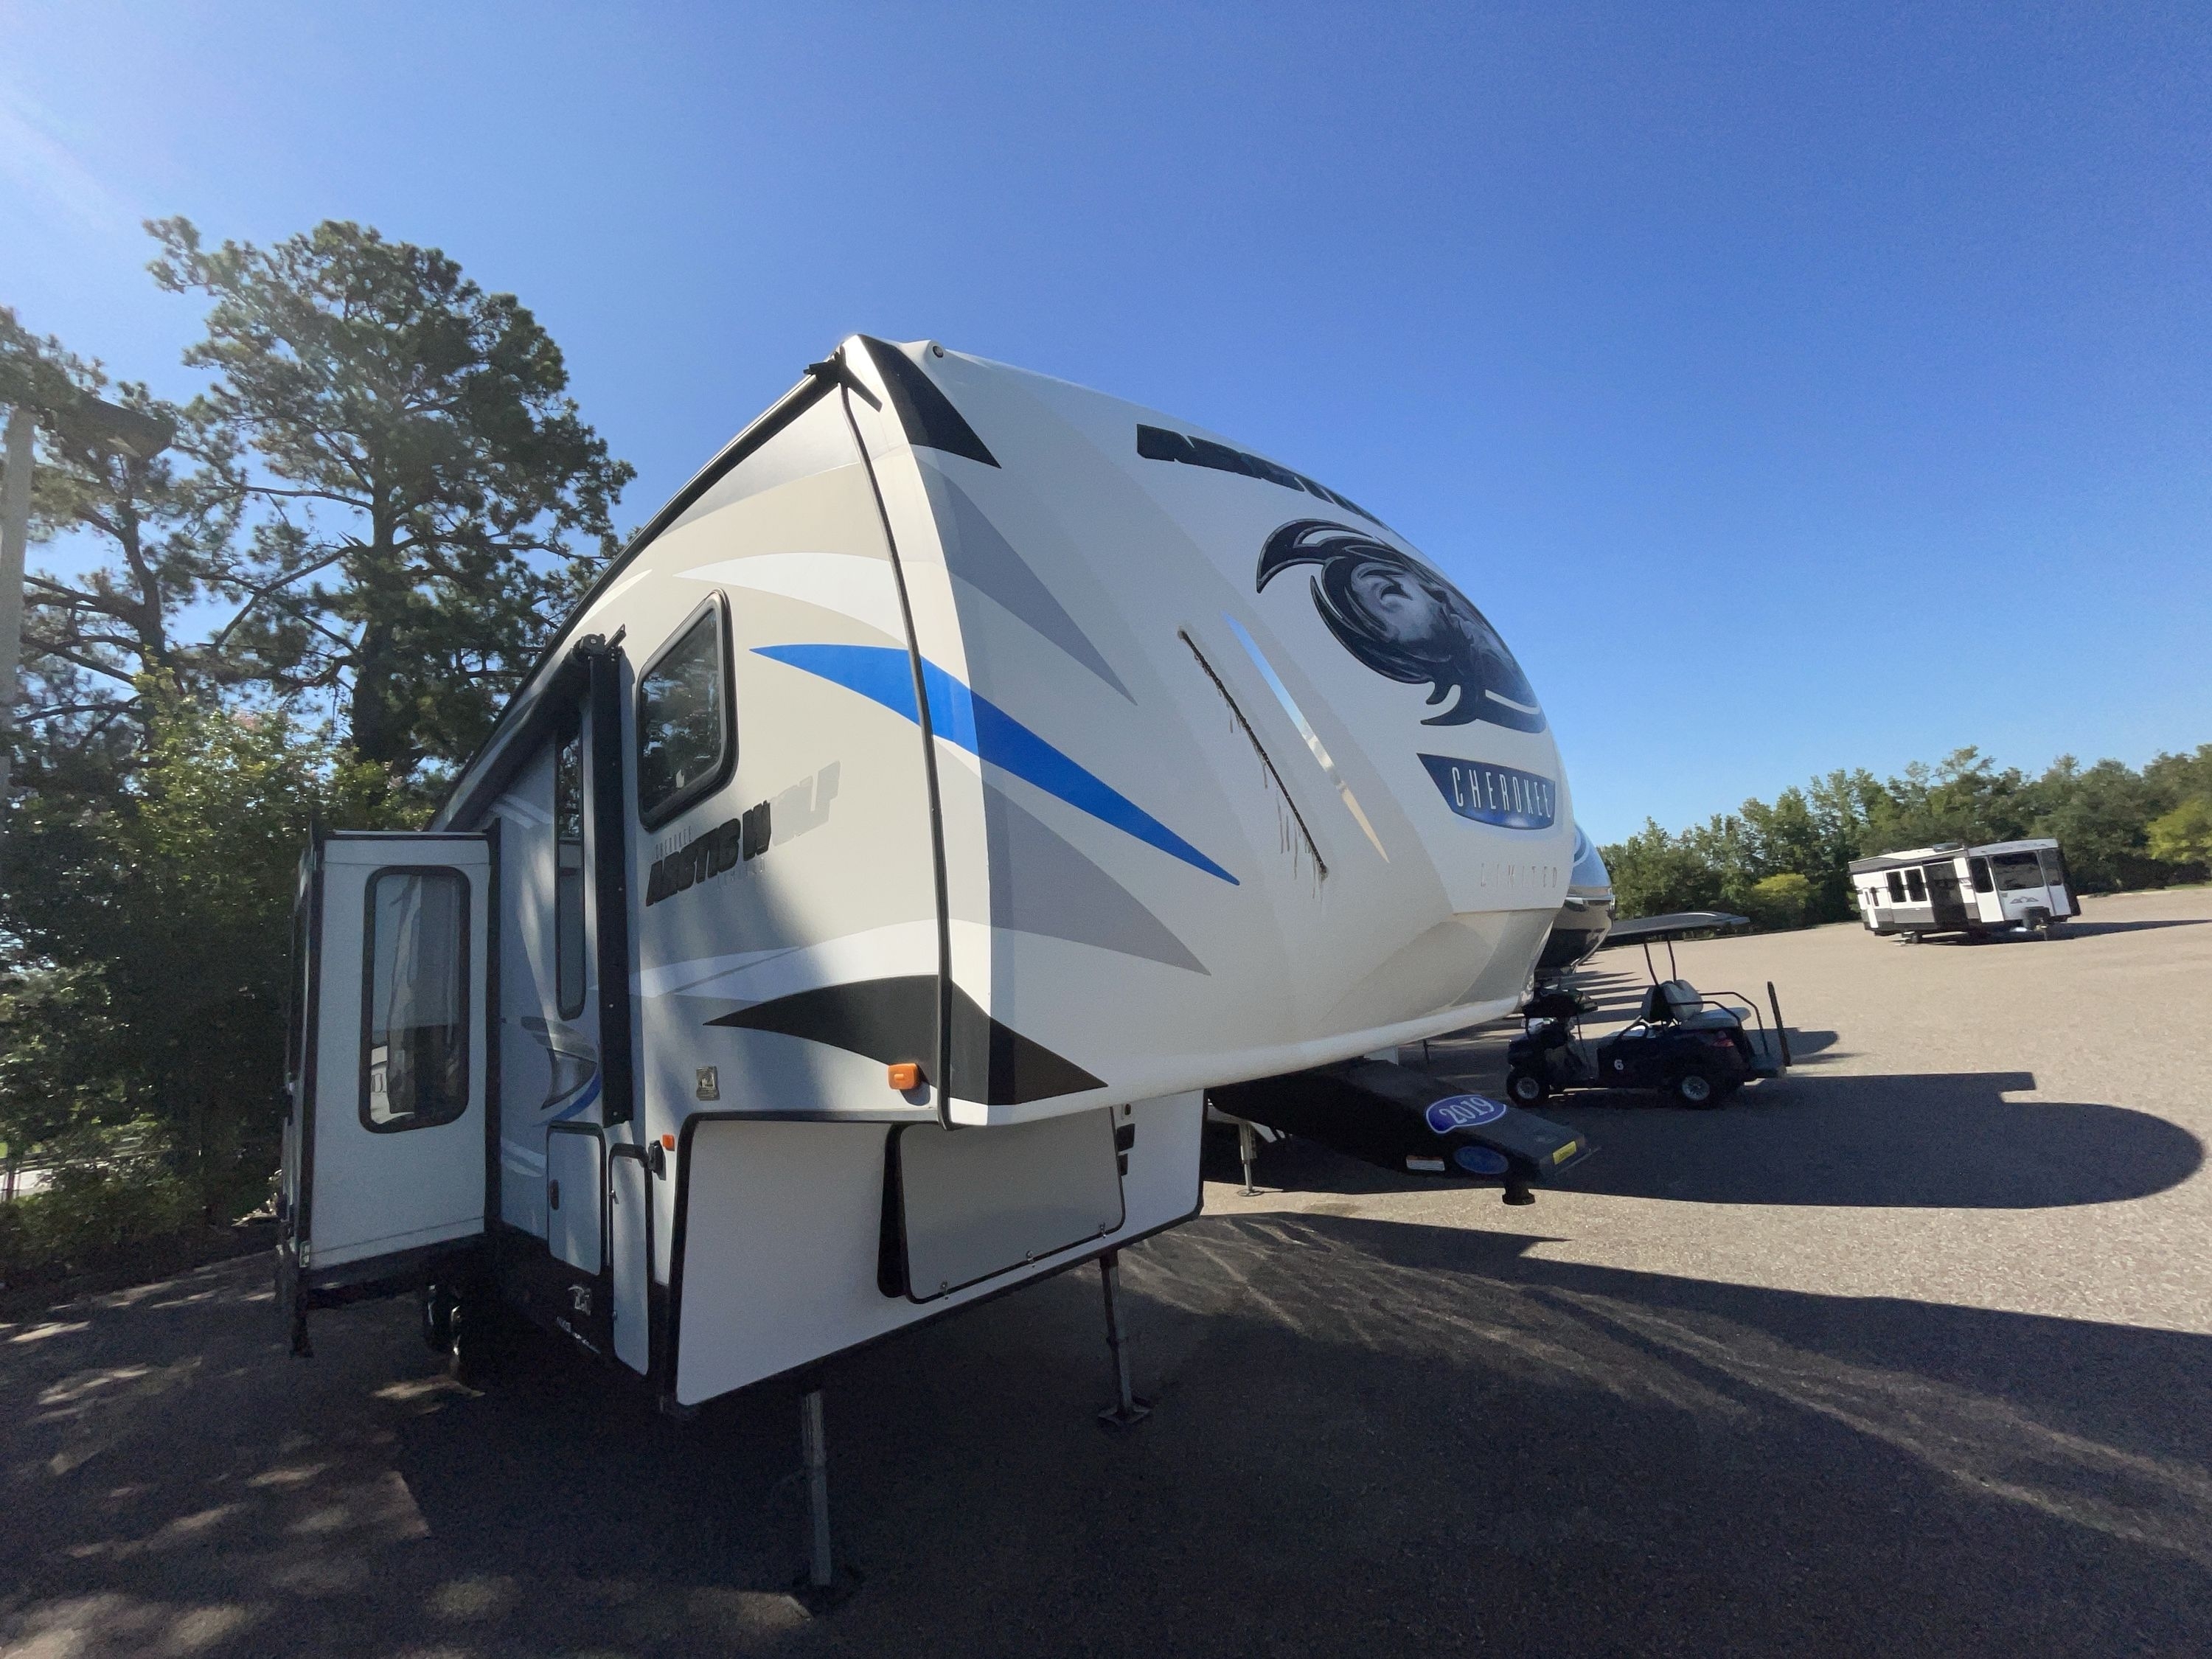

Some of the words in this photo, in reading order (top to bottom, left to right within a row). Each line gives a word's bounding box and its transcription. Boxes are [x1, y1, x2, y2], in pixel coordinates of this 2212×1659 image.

[1451, 766, 1551, 818] CHEROKEE
[1480, 863, 1558, 888] LIMITED
[1439, 1096, 1495, 1124] 2019
